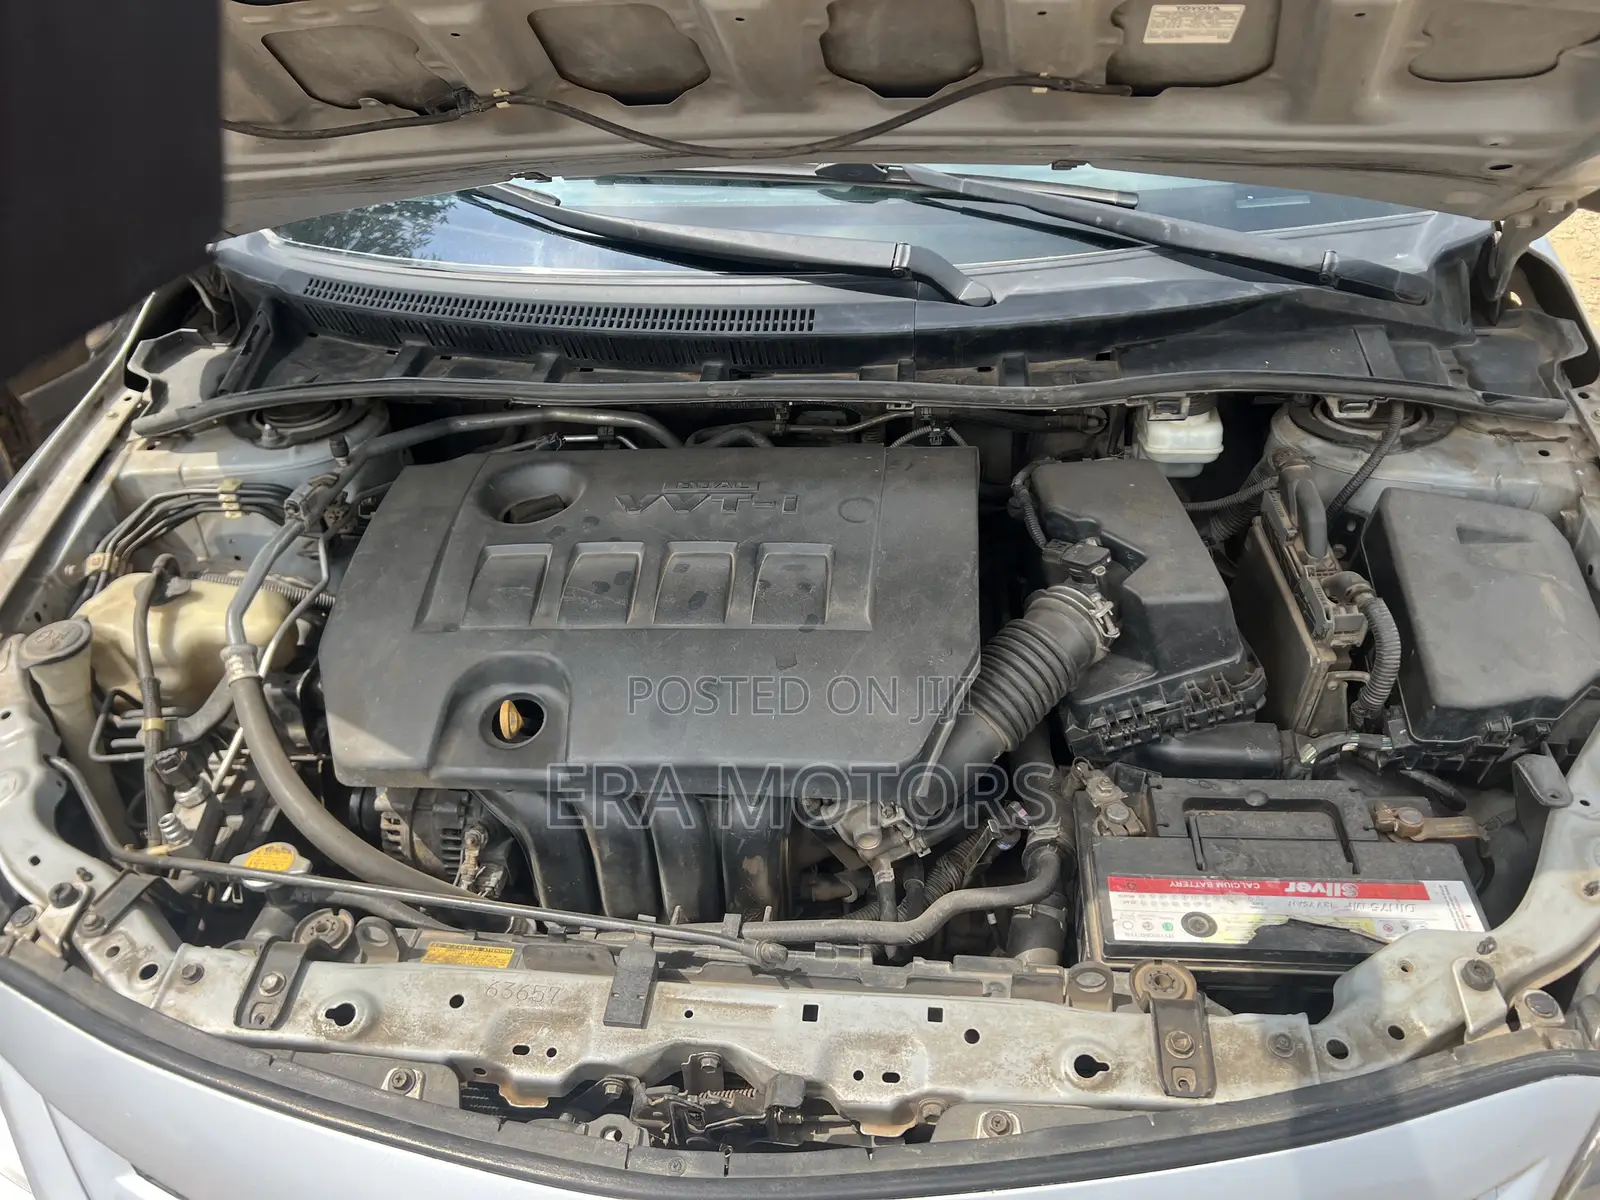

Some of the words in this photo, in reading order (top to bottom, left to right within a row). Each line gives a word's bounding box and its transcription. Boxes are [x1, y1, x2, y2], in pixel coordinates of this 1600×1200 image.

[1170, 880, 1214, 889] BATTERY
[1215, 880, 1260, 890] CALCIUM
[1284, 881, 1359, 898] Silver
[485, 980, 562, 1004] 63657
